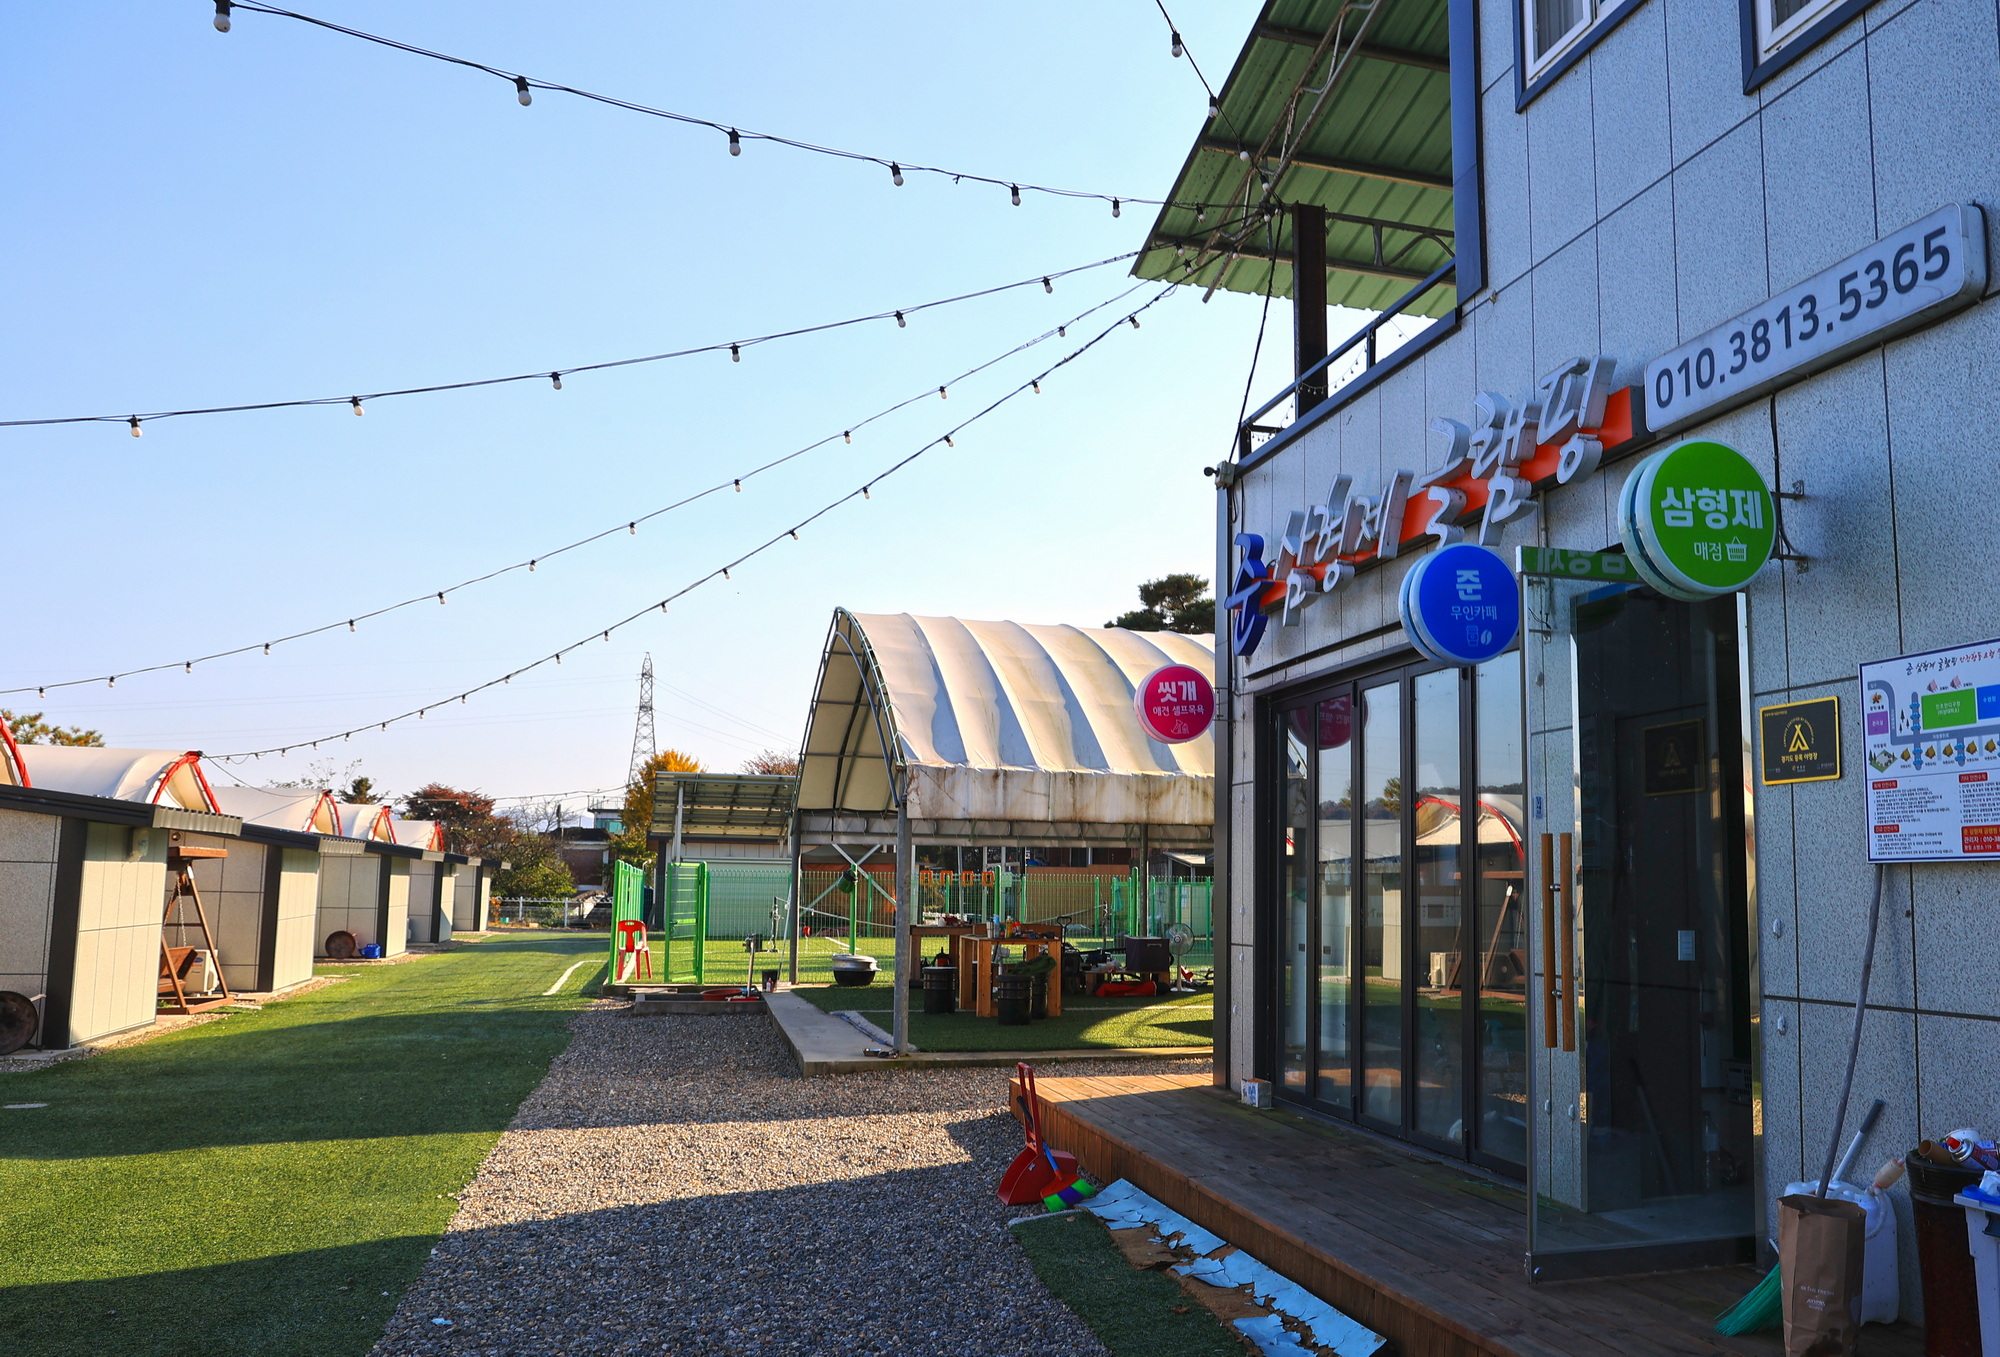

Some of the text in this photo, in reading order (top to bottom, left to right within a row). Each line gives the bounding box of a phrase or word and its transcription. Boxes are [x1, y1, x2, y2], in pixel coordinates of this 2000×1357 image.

[1655, 226, 1950, 408] 010.3813.5365
[1226, 354, 1616, 656] 준 삼형제 글램핑
[1660, 486, 1764, 530] 삼형제
[1694, 541, 1722, 562] 매점
[1456, 569, 1482, 601] 준
[1450, 605, 1498, 621] 무인카페
[1158, 680, 1197, 703] 씻개
[1153, 704, 1205, 717] 애견 셀프목욕
